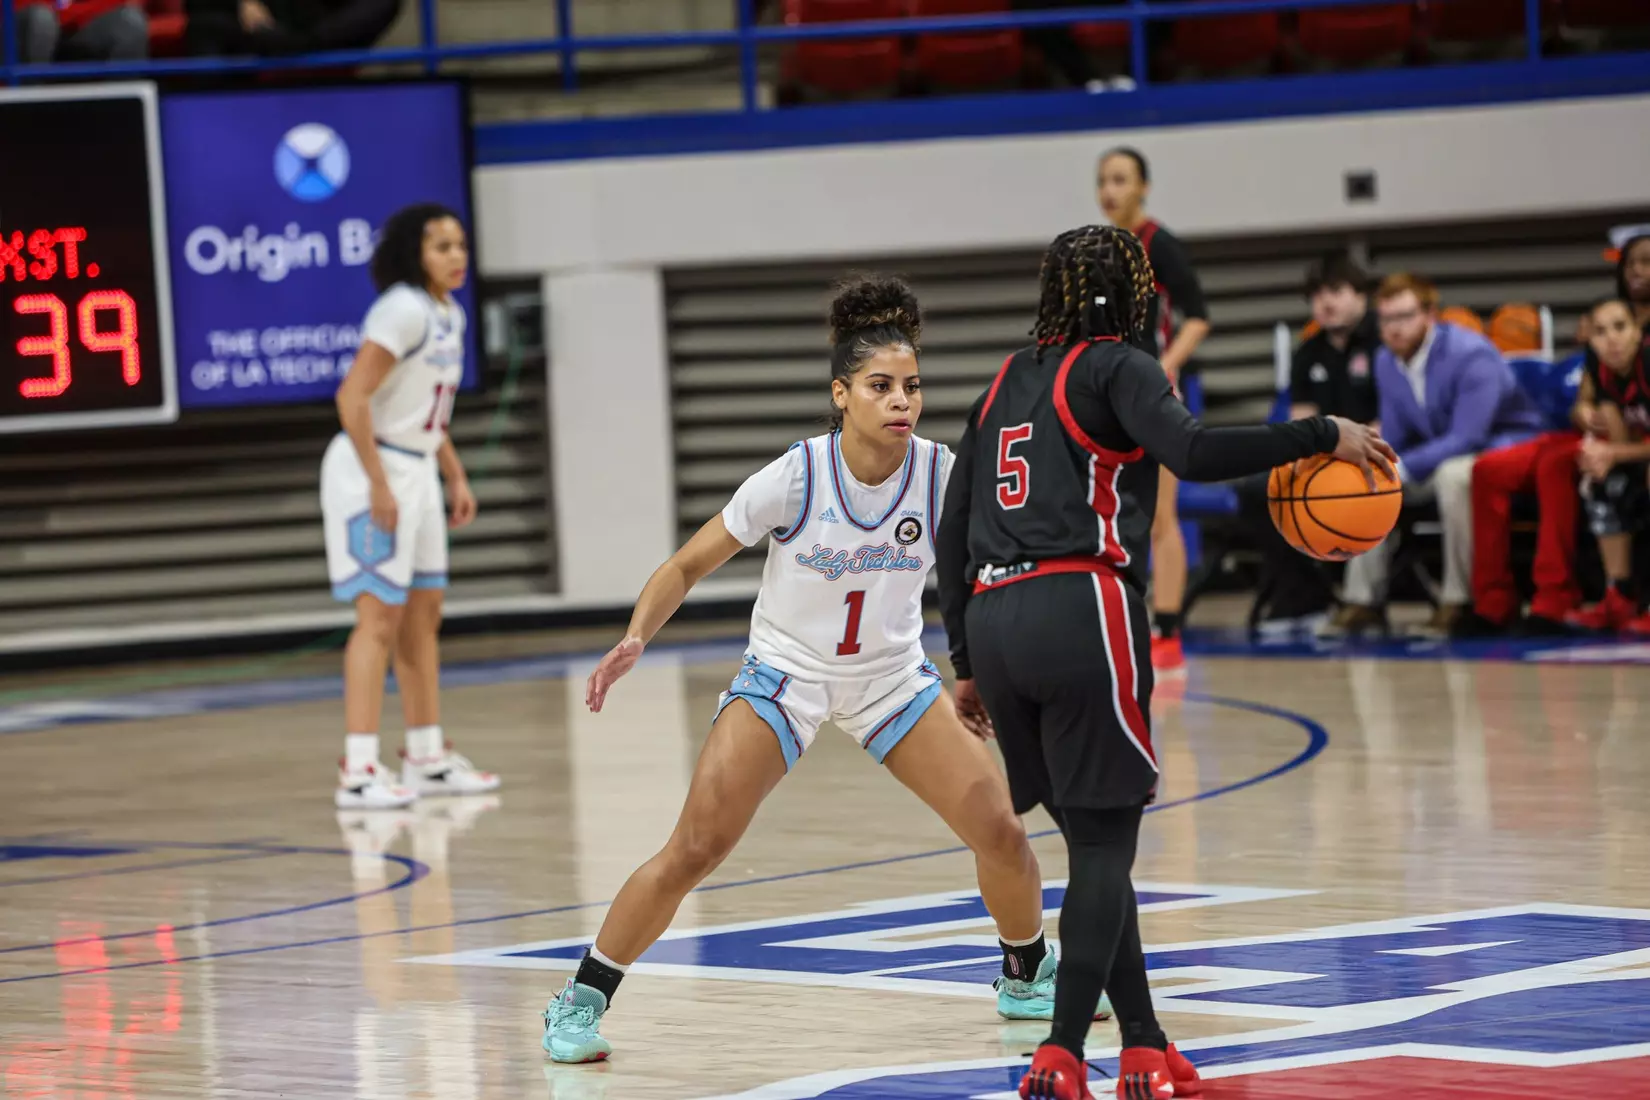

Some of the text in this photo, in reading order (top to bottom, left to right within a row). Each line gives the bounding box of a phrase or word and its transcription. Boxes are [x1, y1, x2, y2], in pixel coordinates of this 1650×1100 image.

[184, 218, 380, 283] Origin B
[14, 291, 140, 397] 39
[209, 329, 259, 358] THE
[191, 360, 228, 390] OF
[231, 358, 268, 387] LA
[268, 354, 335, 385] TECH
[997, 422, 1033, 510] 5
[818, 515, 839, 524] adidas
[795, 542, 923, 581] Lady Techsters
[836, 590, 865, 656] 1
